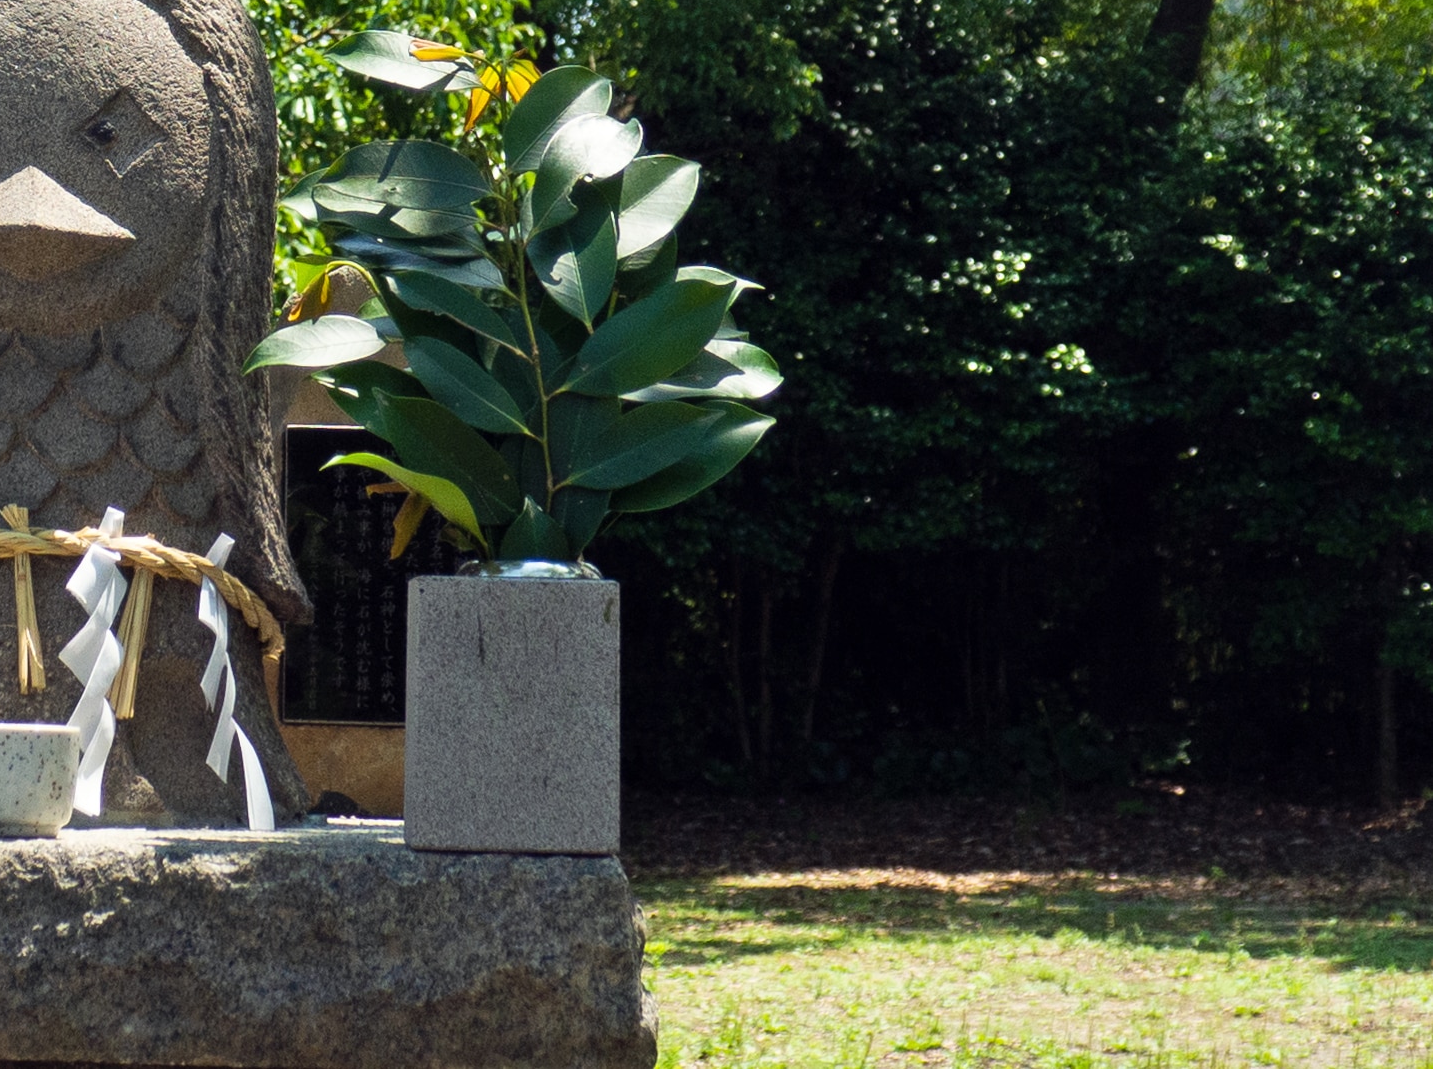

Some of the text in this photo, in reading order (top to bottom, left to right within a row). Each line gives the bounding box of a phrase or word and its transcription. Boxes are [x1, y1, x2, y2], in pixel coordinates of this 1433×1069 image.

[356, 451, 373, 709] や悩み事が、海に石が沈む様に
